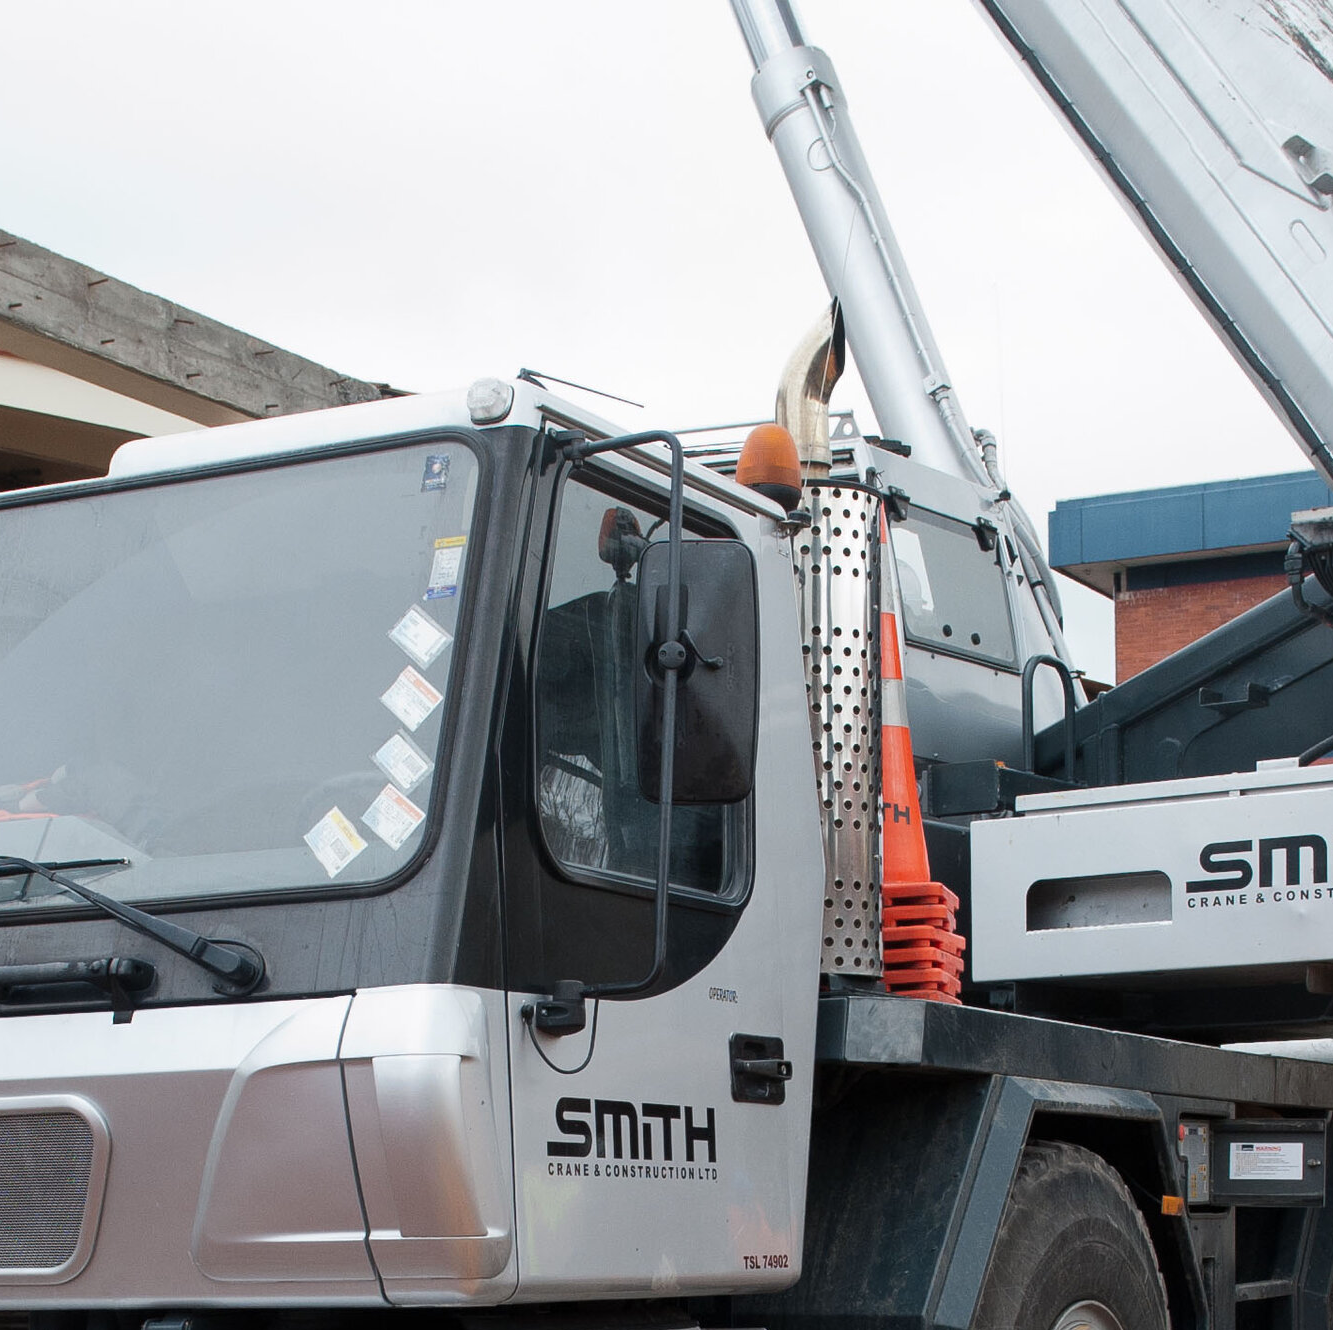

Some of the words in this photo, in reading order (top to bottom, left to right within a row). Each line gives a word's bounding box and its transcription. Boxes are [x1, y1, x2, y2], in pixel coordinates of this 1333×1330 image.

[1186, 894, 1248, 909] CRANE
[1255, 892, 1266, 905] &
[547, 1096, 717, 1163] SMITH
[548, 1163, 590, 1177] CRANE
[594, 1164, 601, 1178] &
[605, 1165, 695, 1180] CONSTRUCTION
[698, 1168, 718, 1181] LTD
[743, 1256, 761, 1270] TSL
[762, 1255, 789, 1269] 74902
